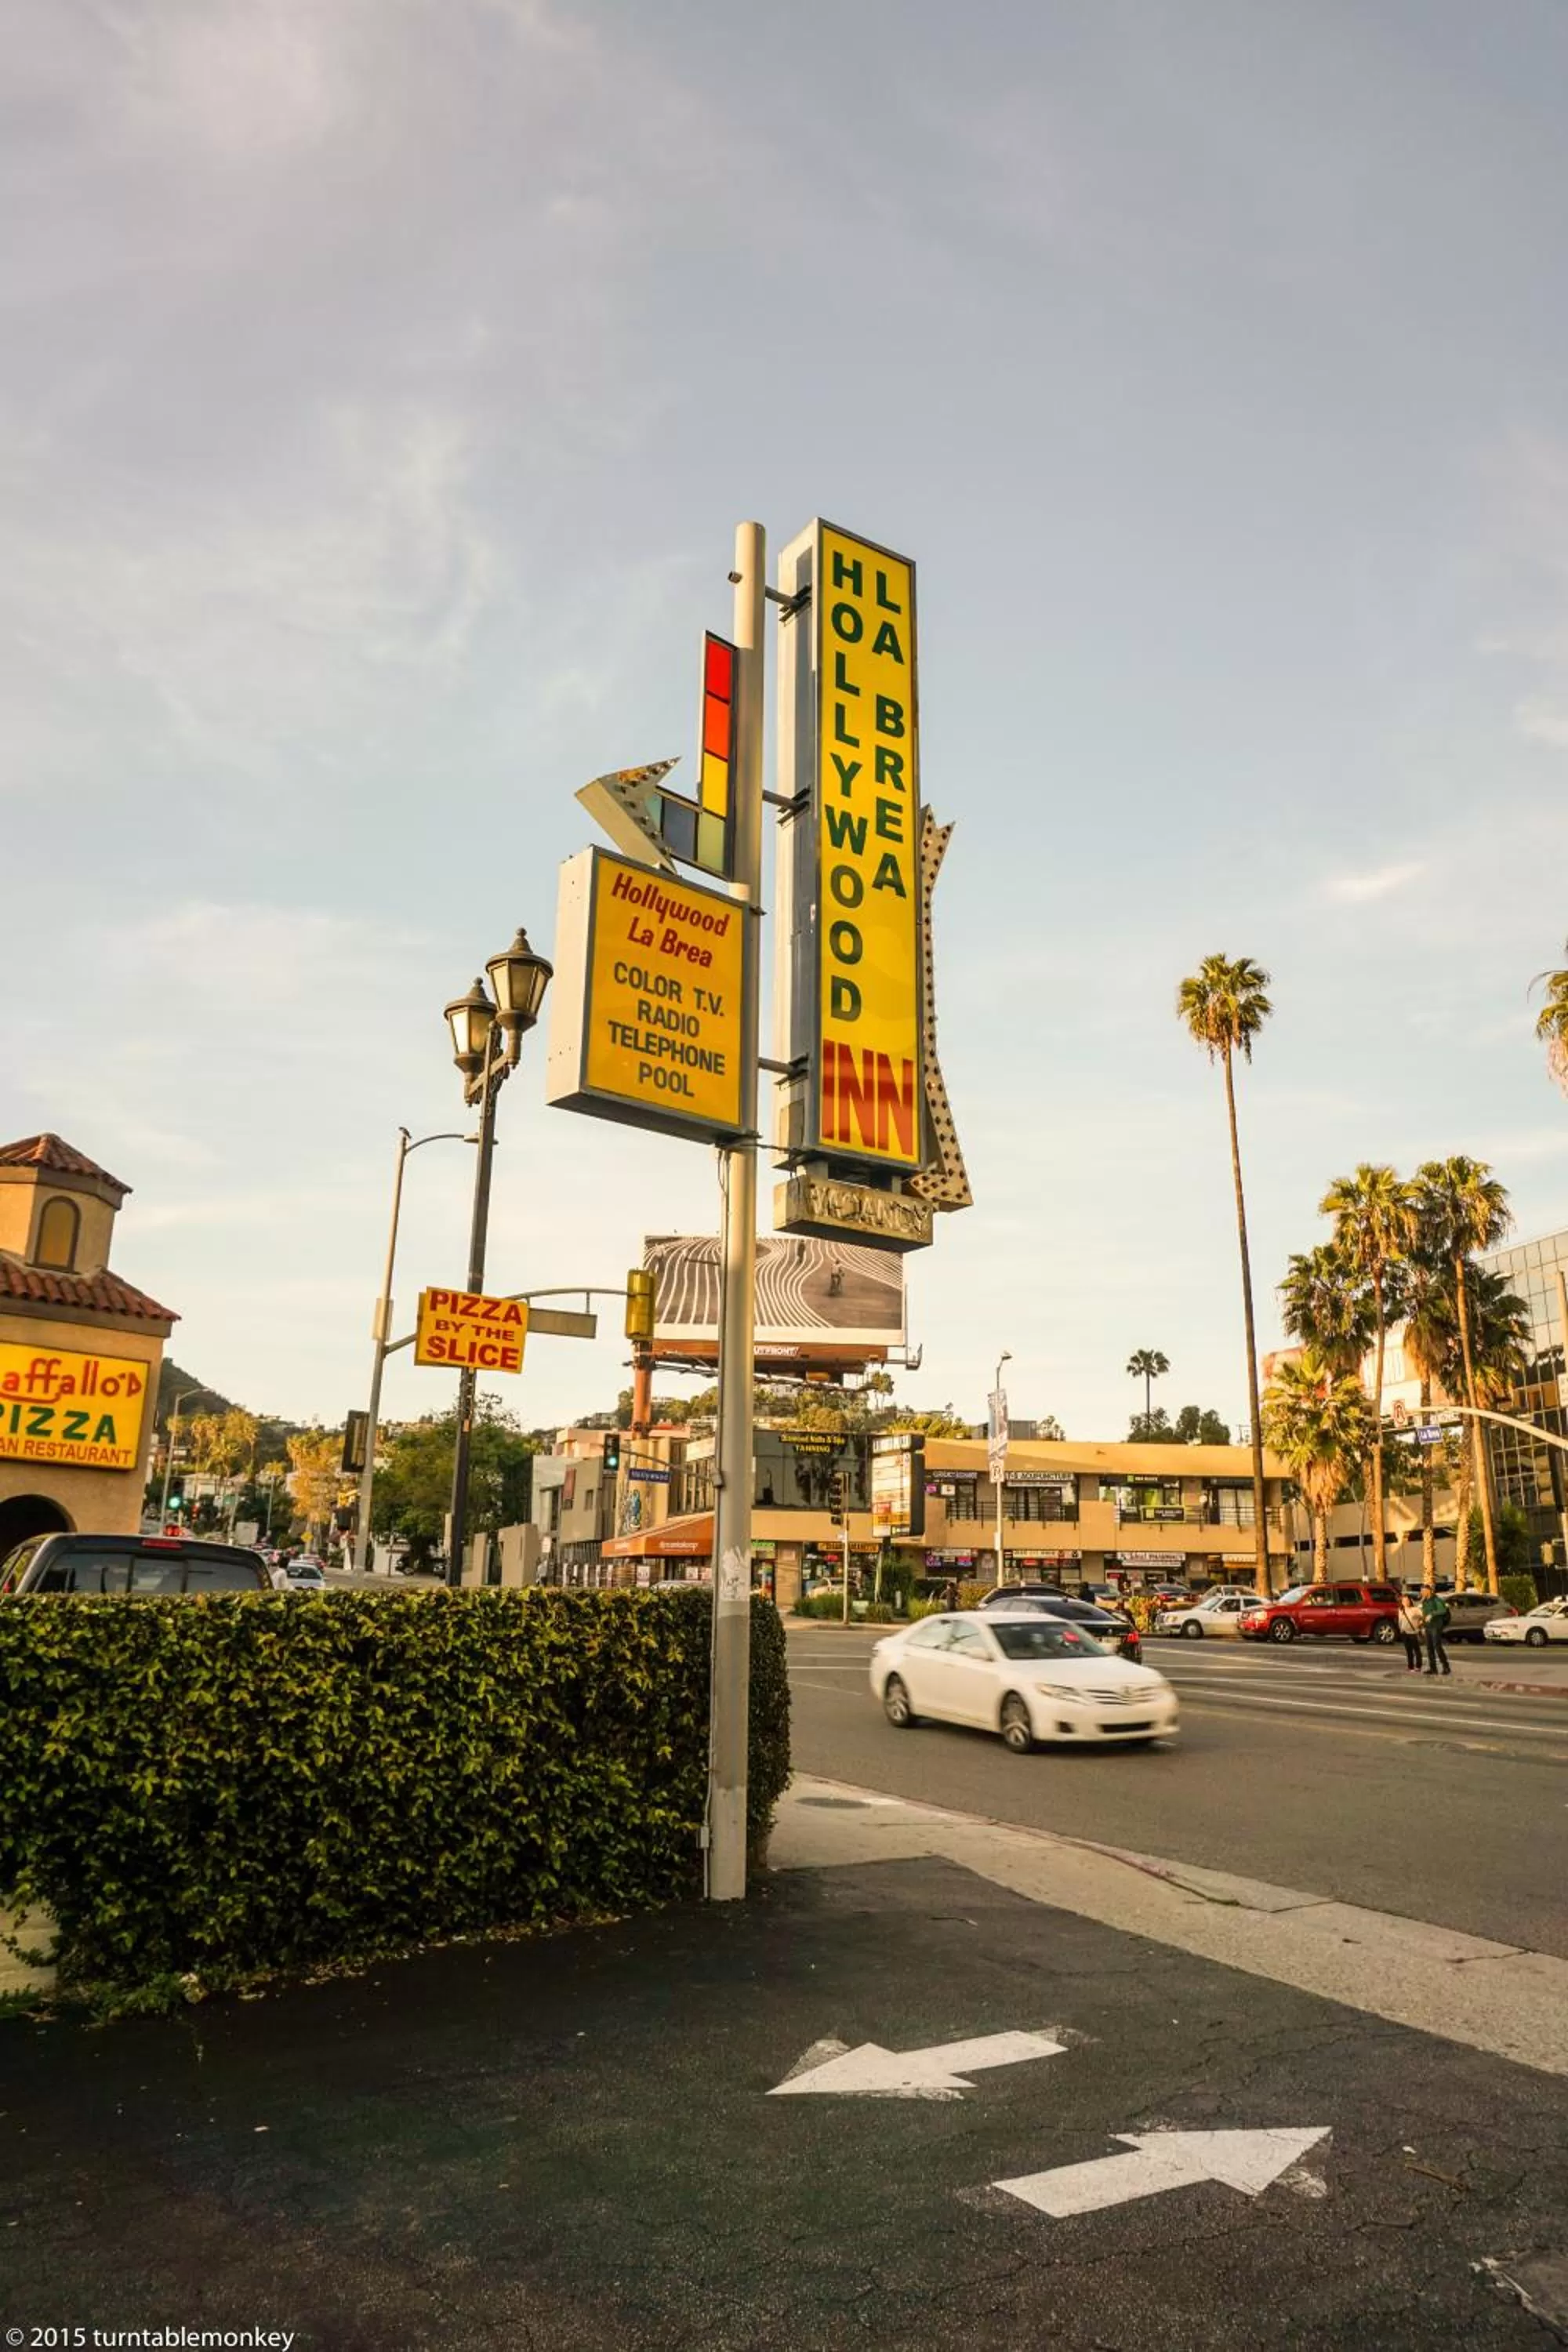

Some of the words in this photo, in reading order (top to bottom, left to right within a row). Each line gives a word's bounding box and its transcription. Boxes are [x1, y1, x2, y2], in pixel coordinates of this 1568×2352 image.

[872, 570, 905, 665] LA
[825, 550, 867, 1022] HOLLYWOOD
[871, 693, 906, 898] BREA
[611, 872, 731, 937] Hollywood
[627, 916, 655, 947] La
[660, 927, 713, 968] Brea
[614, 961, 683, 1004] COLOR
[693, 988, 724, 1017] T.V.
[637, 1000, 700, 1038] RADIO
[608, 1020, 725, 1076] TELEPHONE
[639, 1061, 695, 1098] POOL
[822, 1038, 914, 1156] INN
[430, 1290, 523, 1325] PIZZA
[435, 1319, 466, 1333] BY
[472, 1324, 515, 1341] THE
[426, 1335, 520, 1369] SLICE
[0, 1358, 142, 1404] affallo's
[0, 1404, 116, 1444] IZZA
[23, 1439, 132, 1464] RESTAURANT
